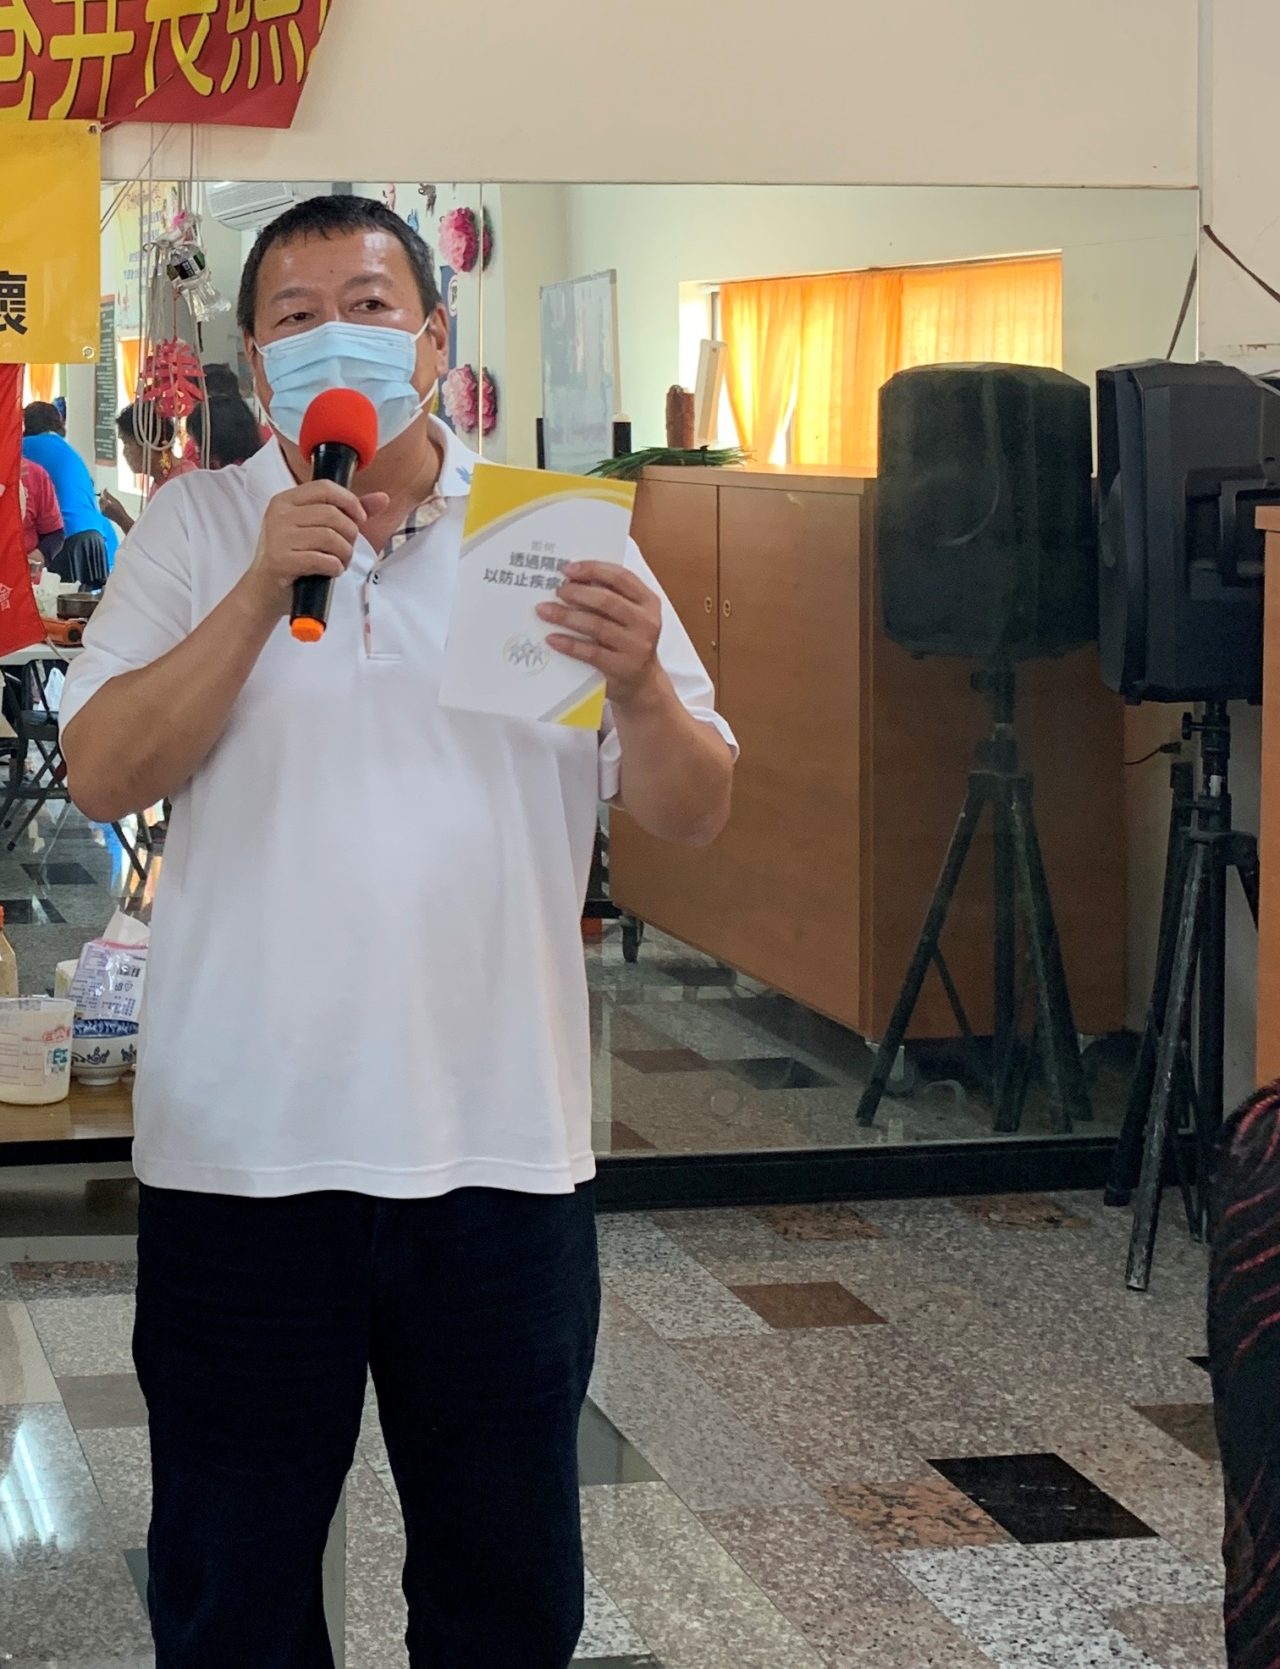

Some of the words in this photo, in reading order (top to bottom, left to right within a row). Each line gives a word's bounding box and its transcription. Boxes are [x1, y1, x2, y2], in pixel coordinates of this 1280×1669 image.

[483, 567, 566, 590] 以防止疾病
